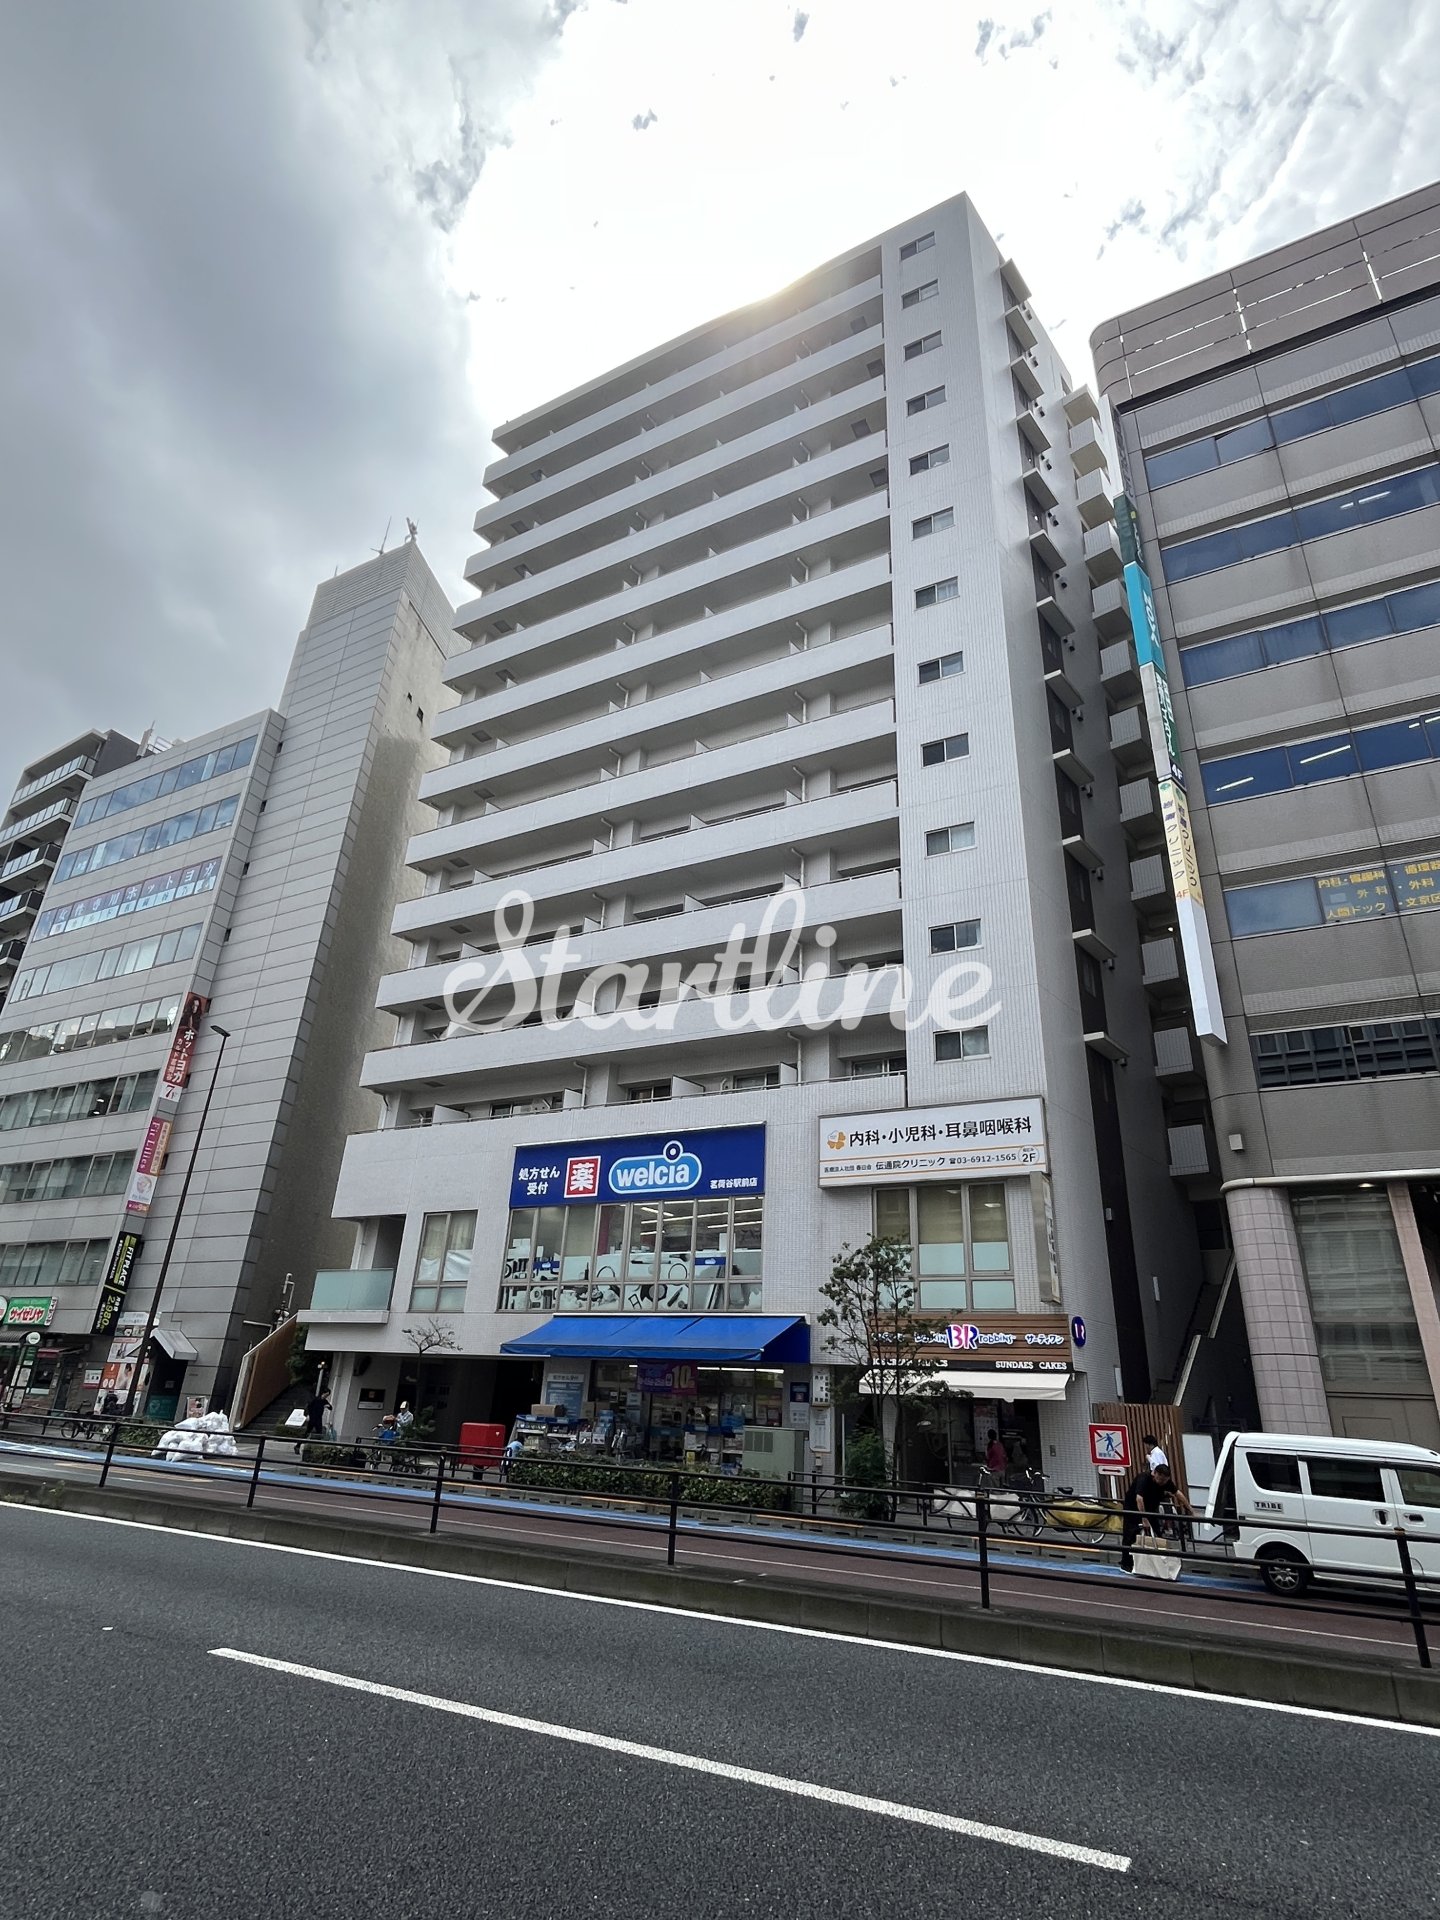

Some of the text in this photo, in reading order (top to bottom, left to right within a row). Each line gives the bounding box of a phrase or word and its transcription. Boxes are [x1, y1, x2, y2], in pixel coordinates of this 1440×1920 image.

[1171, 762, 1183, 780] 4F
[1327, 902, 1385, 919] 人間ドック
[171, 1029, 195, 1083] ホットヨガ
[849, 1116, 1032, 1148] 内科・小児科・耳鼻咽喉科
[875, 1157, 946, 1171] 伝通院クリニック
[957, 1153, 1017, 1165] 03-6912-1565
[1022, 1153, 1036, 1163] 2F
[518, 1165, 560, 1180] 処方せん
[569, 1162, 596, 1192] 薬
[616, 1161, 690, 1187] welcia
[526, 1182, 549, 1196] 受付
[709, 1177, 758, 1190] 茗荷谷駅前店
[126, 1246, 135, 1260] FIT
[118, 1259, 131, 1286] PLACE
[9, 1306, 45, 1323] サイゼリヤ
[946, 1324, 979, 1350] BR
[1024, 1334, 1065, 1345] サーティワン
[995, 1360, 1068, 1371] SUNDAES CAKES
[1255, 1502, 1283, 1510] TRIBE
